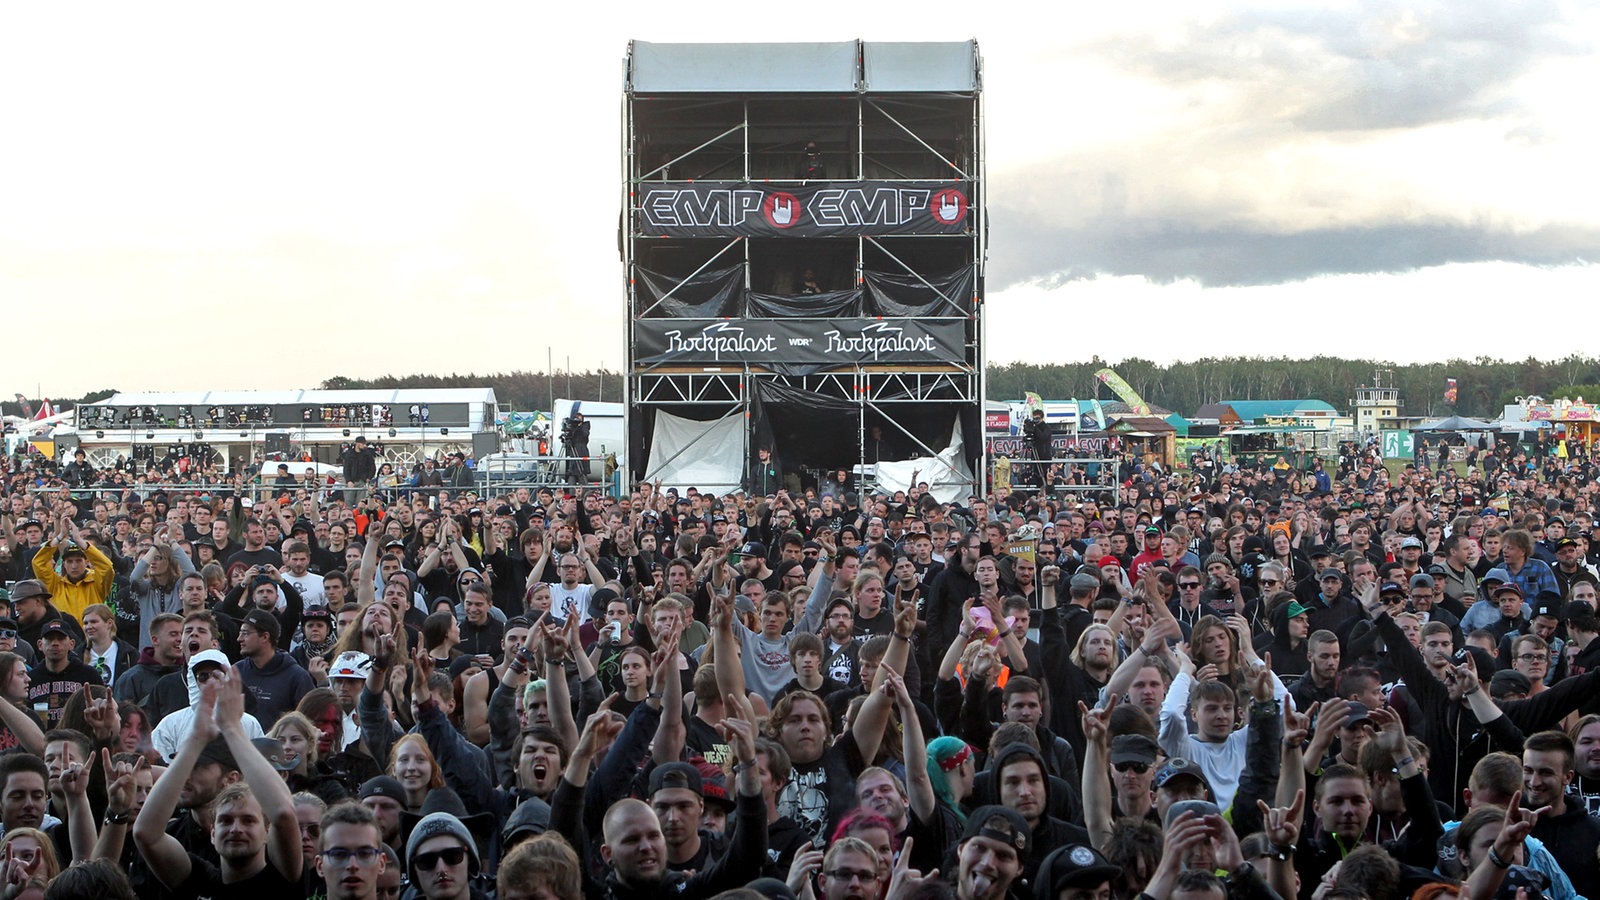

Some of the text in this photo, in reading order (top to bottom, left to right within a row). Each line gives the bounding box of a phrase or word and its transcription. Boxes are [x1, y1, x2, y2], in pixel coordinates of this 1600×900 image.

[642, 188, 930, 227] EMP EMP
[664, 322, 777, 361] Rockpalast
[823, 322, 937, 361] Rockpalast
[1009, 545, 1031, 553] BIER
[30, 682, 50, 700] SAN
